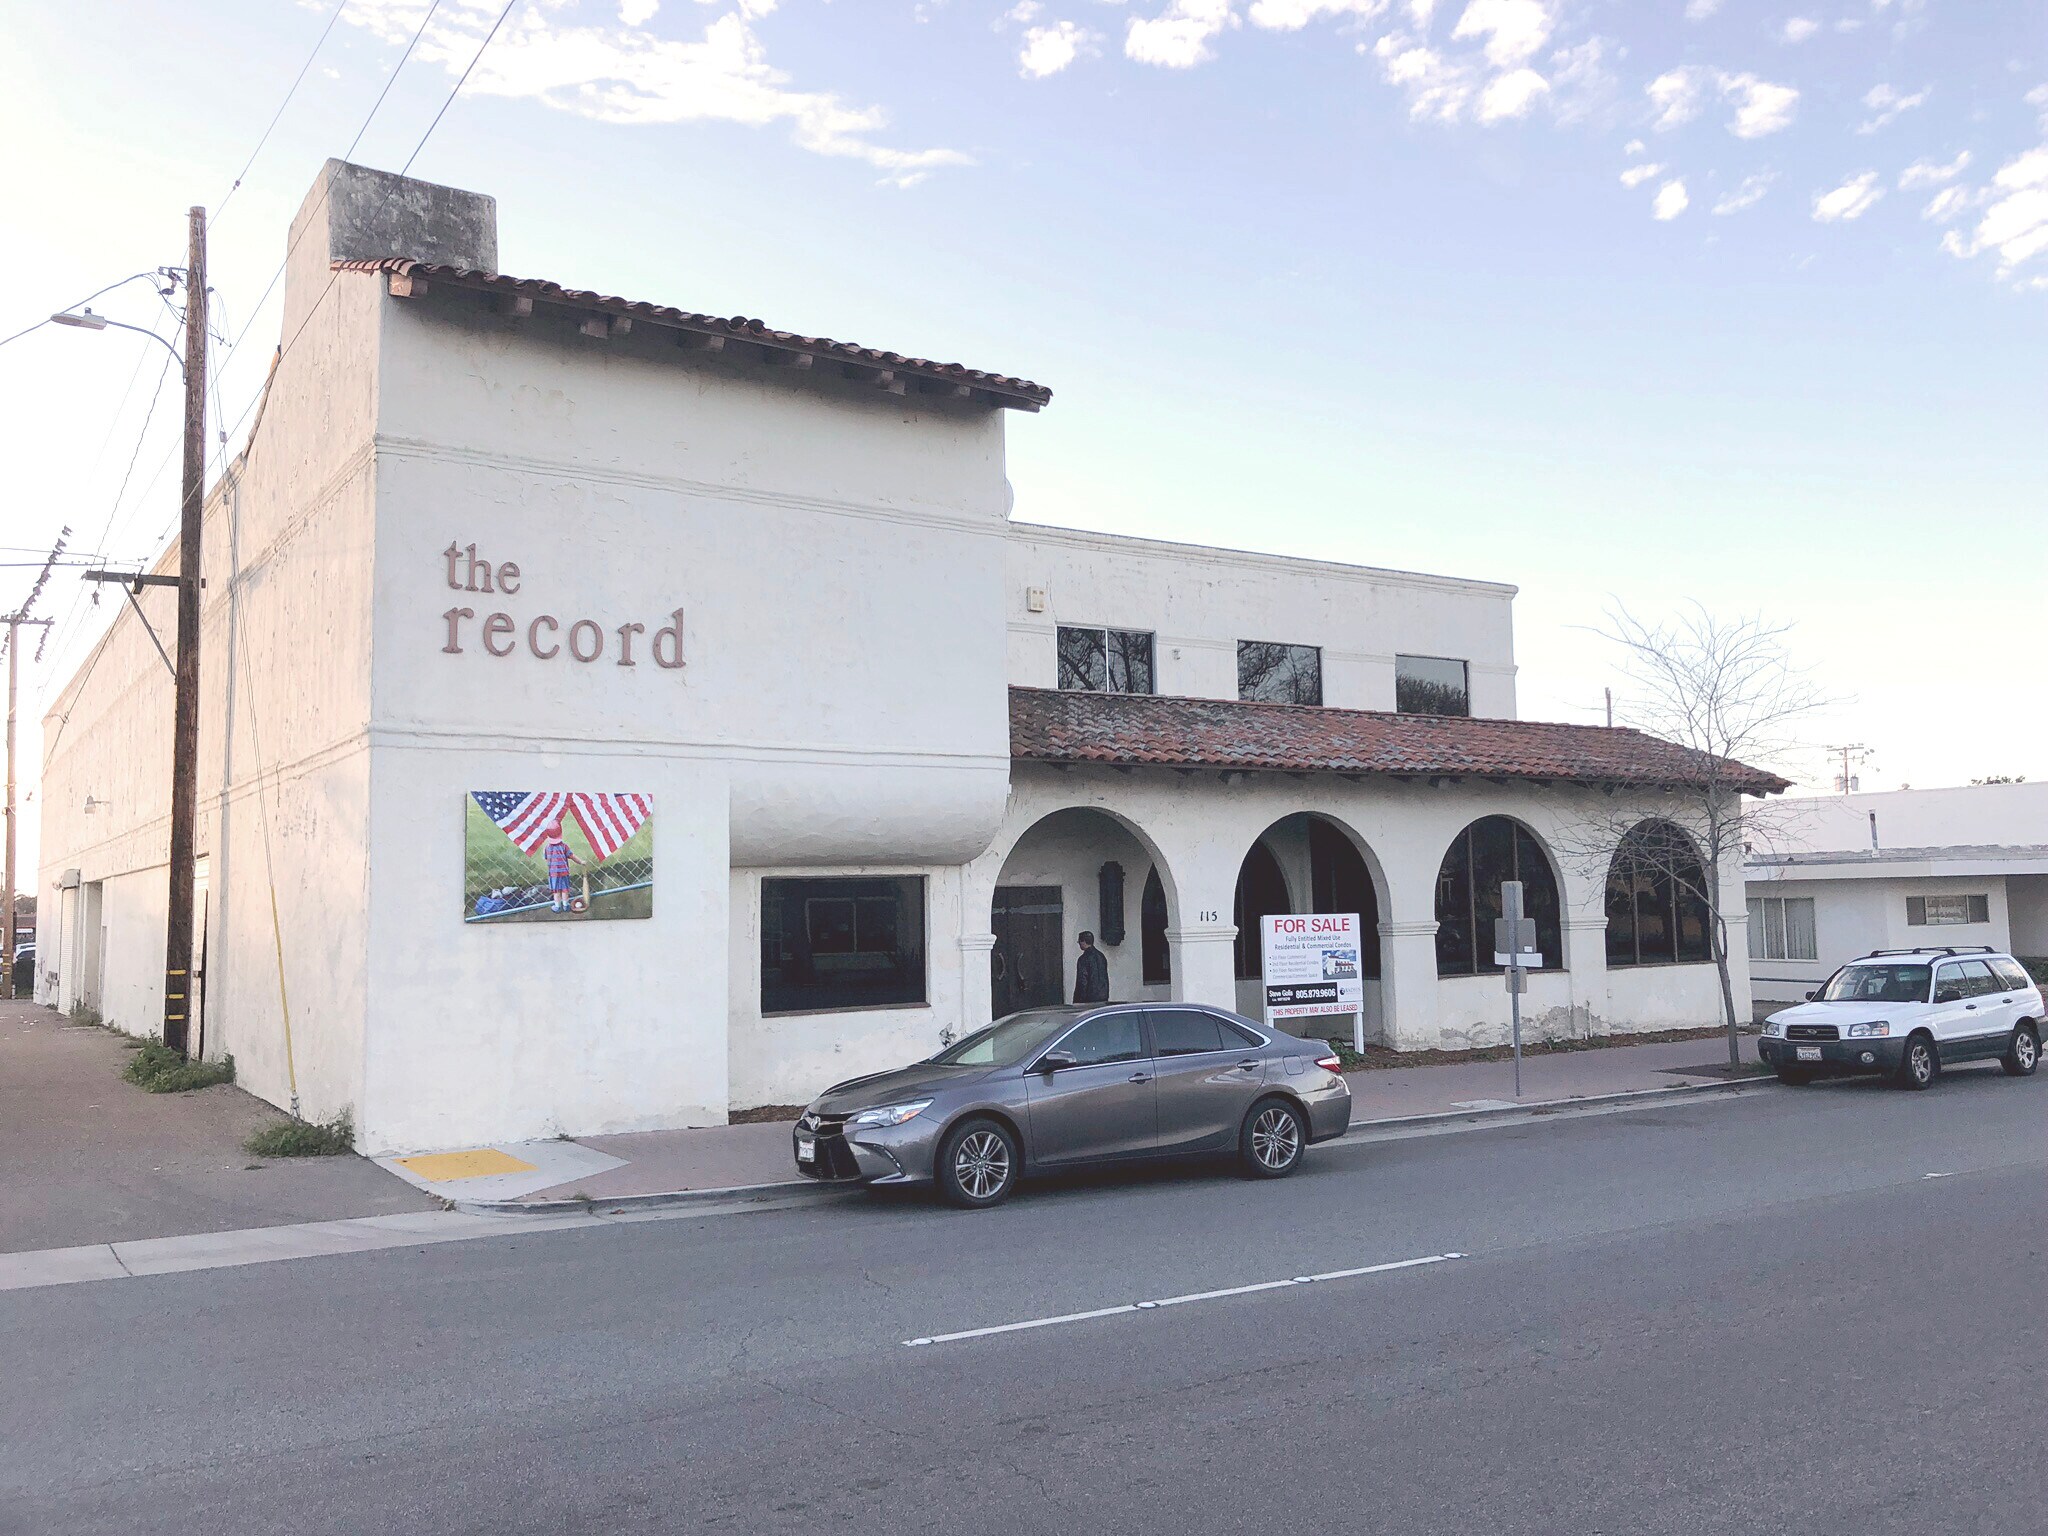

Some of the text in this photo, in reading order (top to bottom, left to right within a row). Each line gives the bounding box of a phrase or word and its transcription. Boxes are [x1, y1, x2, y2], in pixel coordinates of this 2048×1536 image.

[443, 540, 521, 595] the
[442, 606, 687, 669] record
[1200, 910, 1218, 922] 115
[1274, 918, 1351, 933] FOR SALE
[1285, 935, 1297, 943] Fully
[1295, 988, 1336, 999] 805.879.9606
[1273, 1003, 1358, 1016] THIS PROPERTY MAY ALSO BE LEASED
